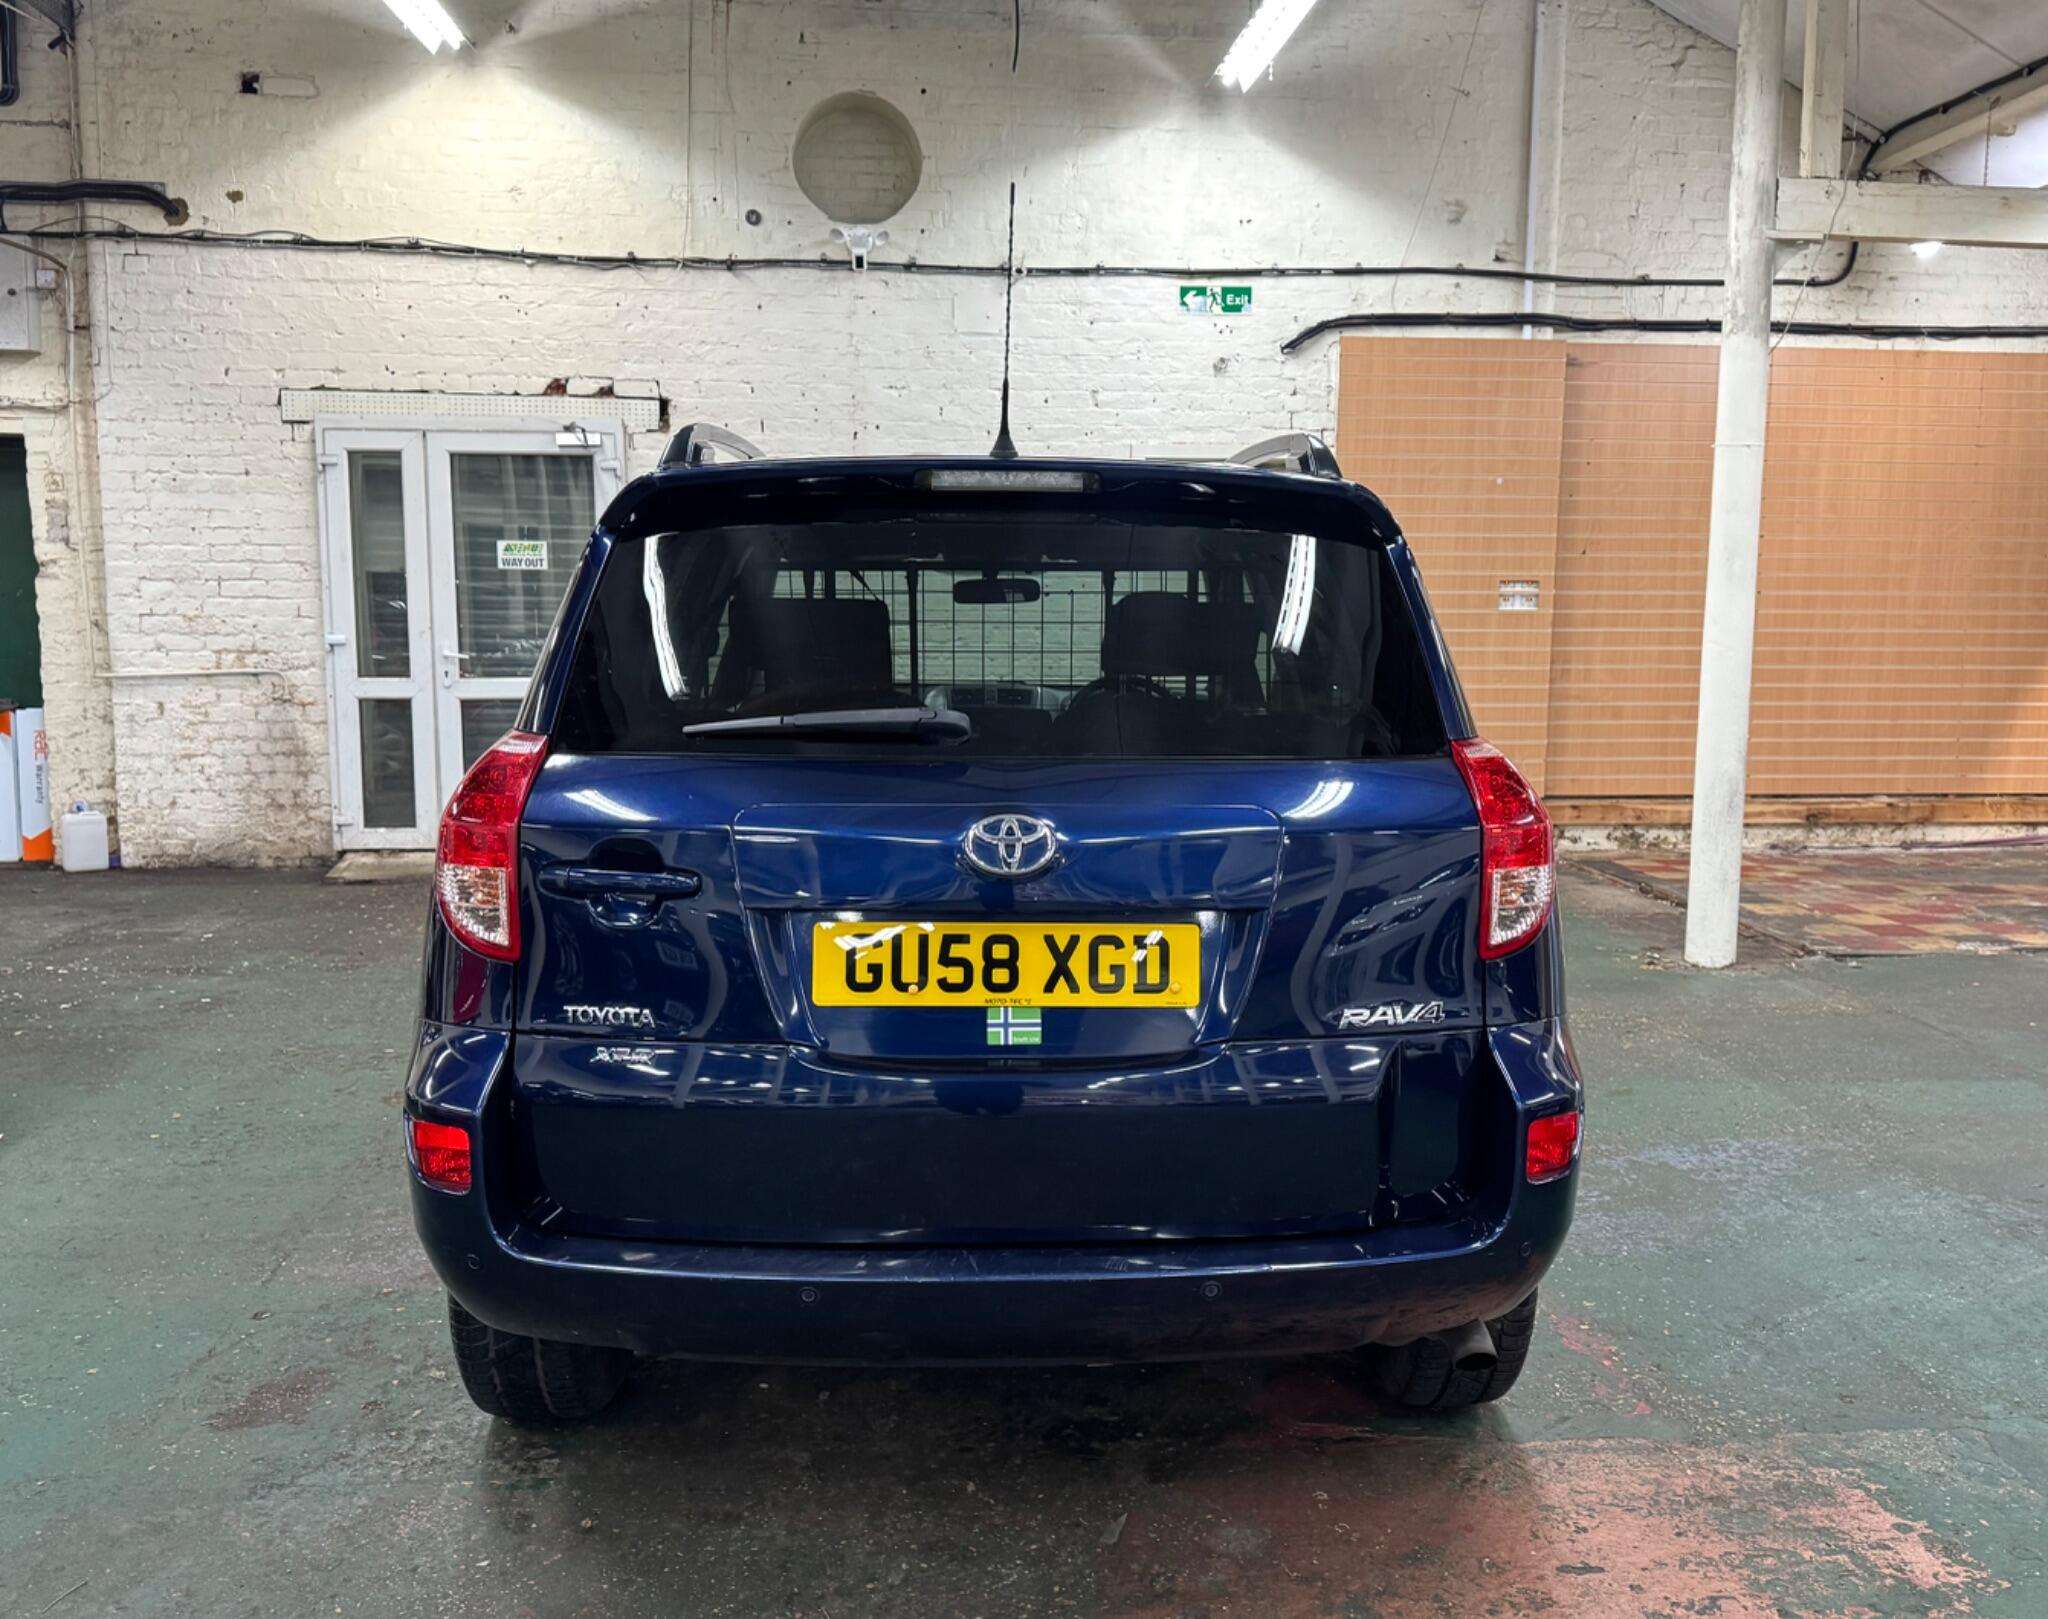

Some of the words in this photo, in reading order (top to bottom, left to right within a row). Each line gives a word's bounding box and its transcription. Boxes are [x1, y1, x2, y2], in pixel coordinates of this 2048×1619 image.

[1226, 294, 1249, 305] Exit
[502, 558, 522, 567] WAY
[524, 558, 544, 567] OUT
[845, 933, 1020, 994] GU58
[1042, 933, 1171, 994] XGD
[563, 1005, 655, 1028] TOYOTA
[1338, 1001, 1446, 1030] RAV4
